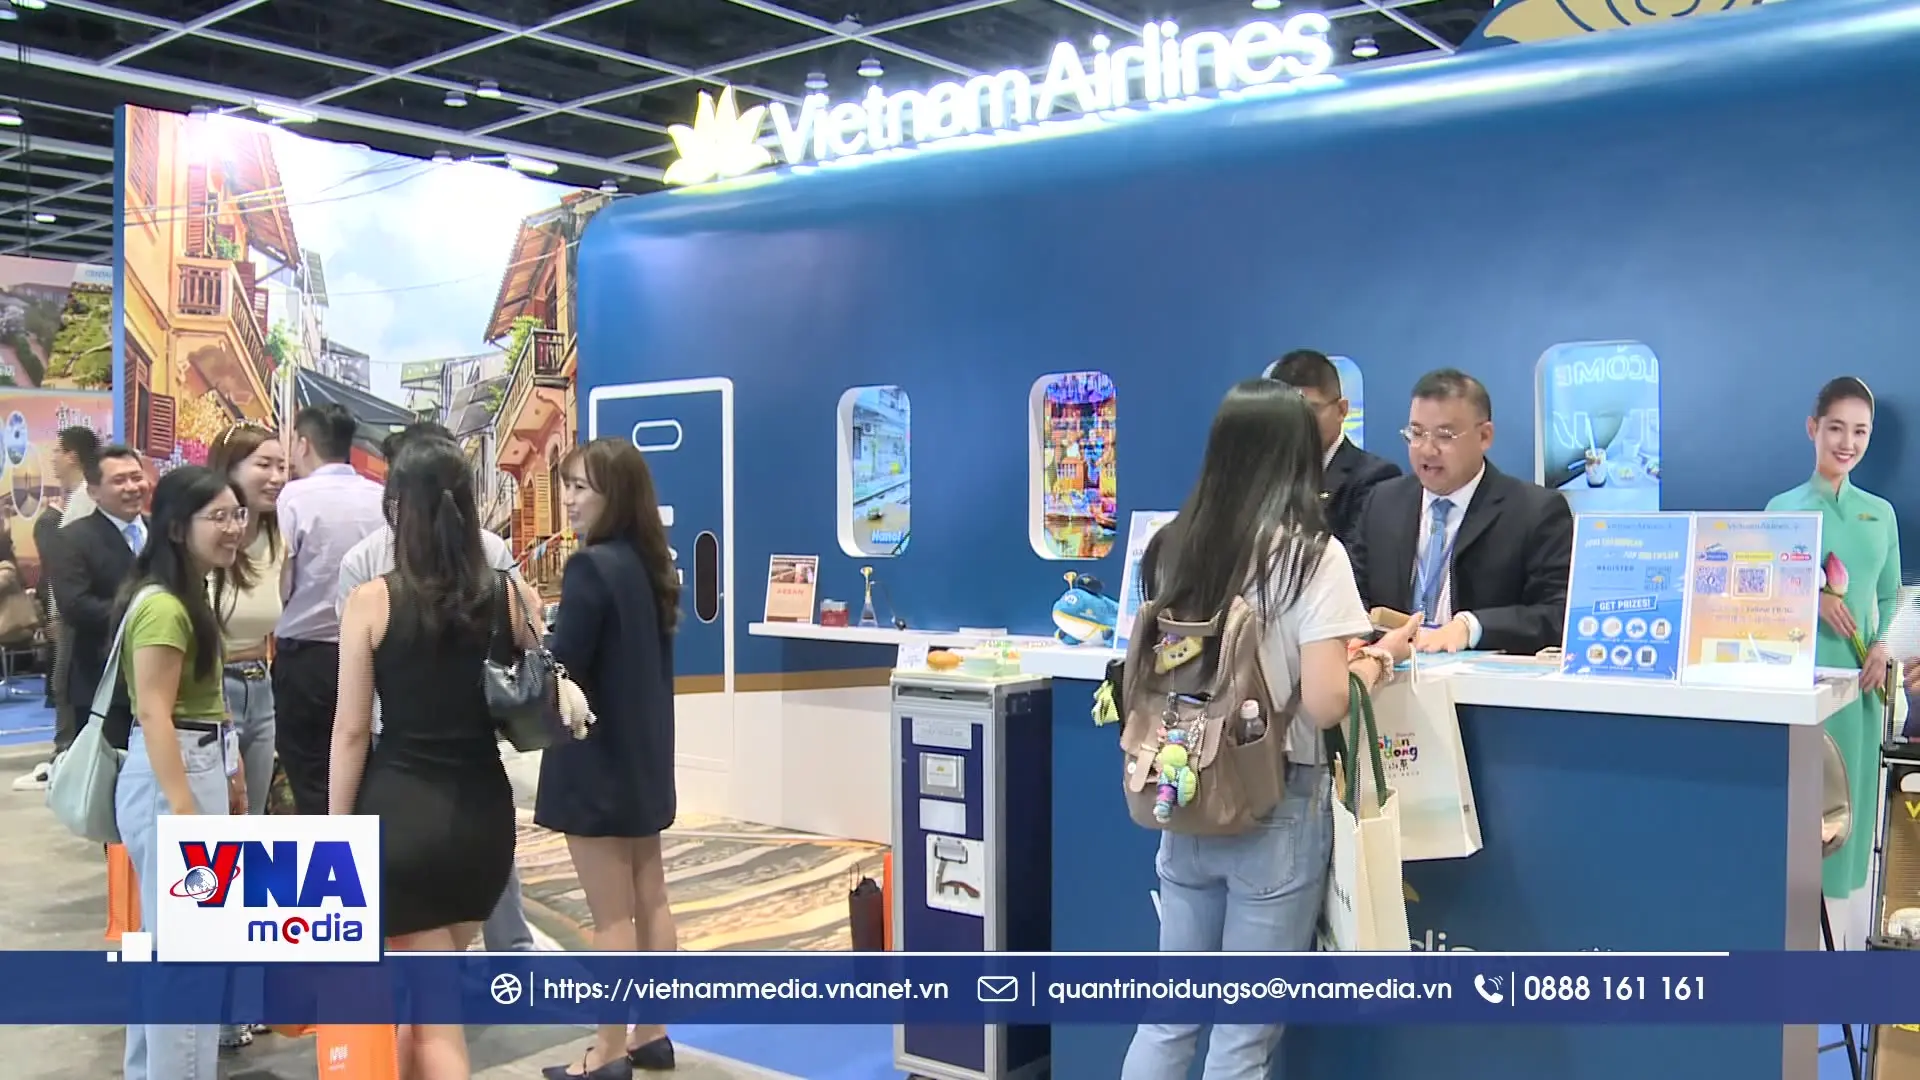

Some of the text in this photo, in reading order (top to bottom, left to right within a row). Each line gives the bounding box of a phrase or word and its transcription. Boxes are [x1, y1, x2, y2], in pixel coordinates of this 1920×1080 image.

[768, 12, 1332, 167] Vietnam Airlines
[1599, 598, 1651, 611] GET PRIZES!
